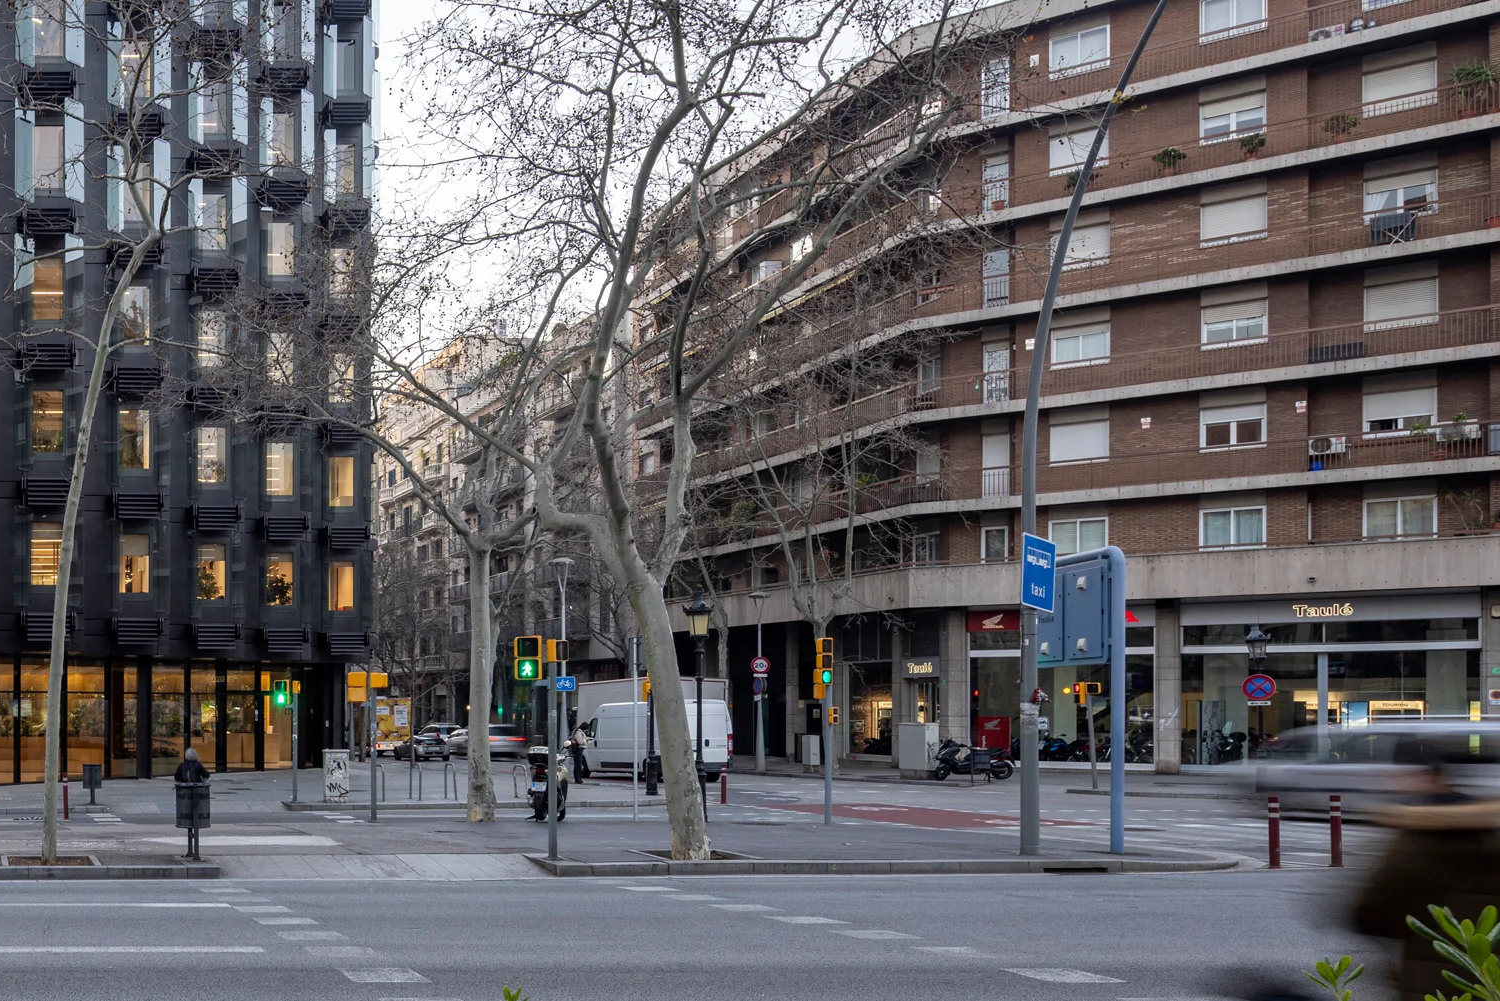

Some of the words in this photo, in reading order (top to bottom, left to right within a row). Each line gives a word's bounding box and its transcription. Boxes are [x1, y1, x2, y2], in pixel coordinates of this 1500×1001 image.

[1031, 582, 1046, 598] taxi
[1292, 602, 1354, 617] Taulé
[907, 662, 933, 674] Taulé
